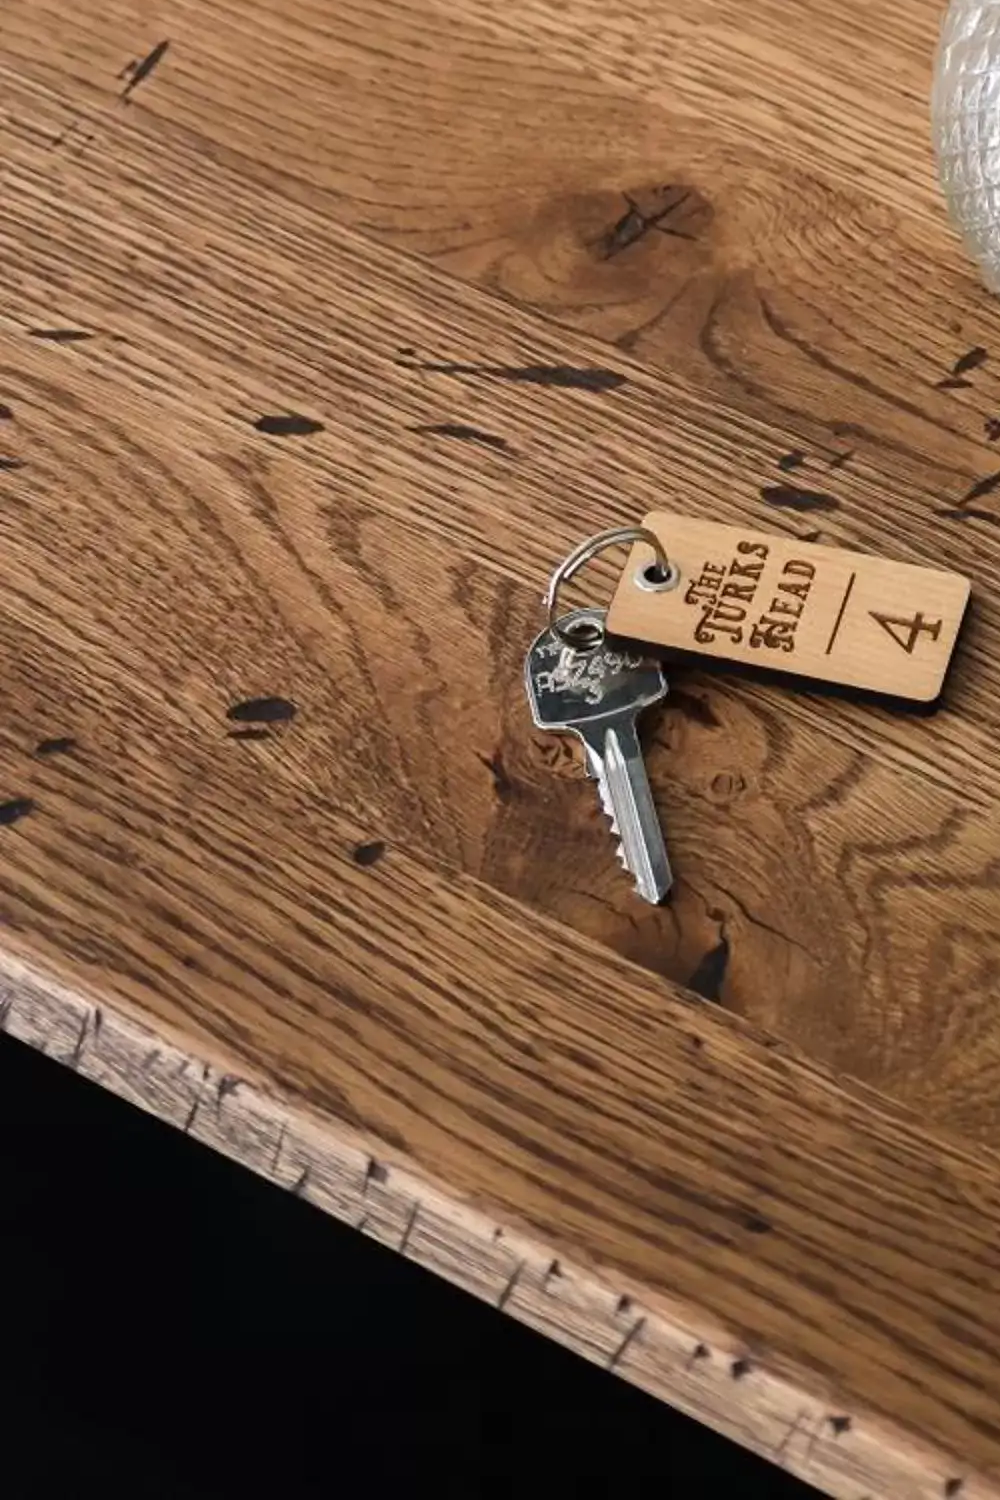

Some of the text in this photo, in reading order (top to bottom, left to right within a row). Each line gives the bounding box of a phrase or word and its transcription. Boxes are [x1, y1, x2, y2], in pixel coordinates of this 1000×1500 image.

[684, 561, 726, 606] THE
[694, 541, 769, 644] TURKS
[749, 559, 816, 652] HEAD
[867, 611, 943, 654] 4
